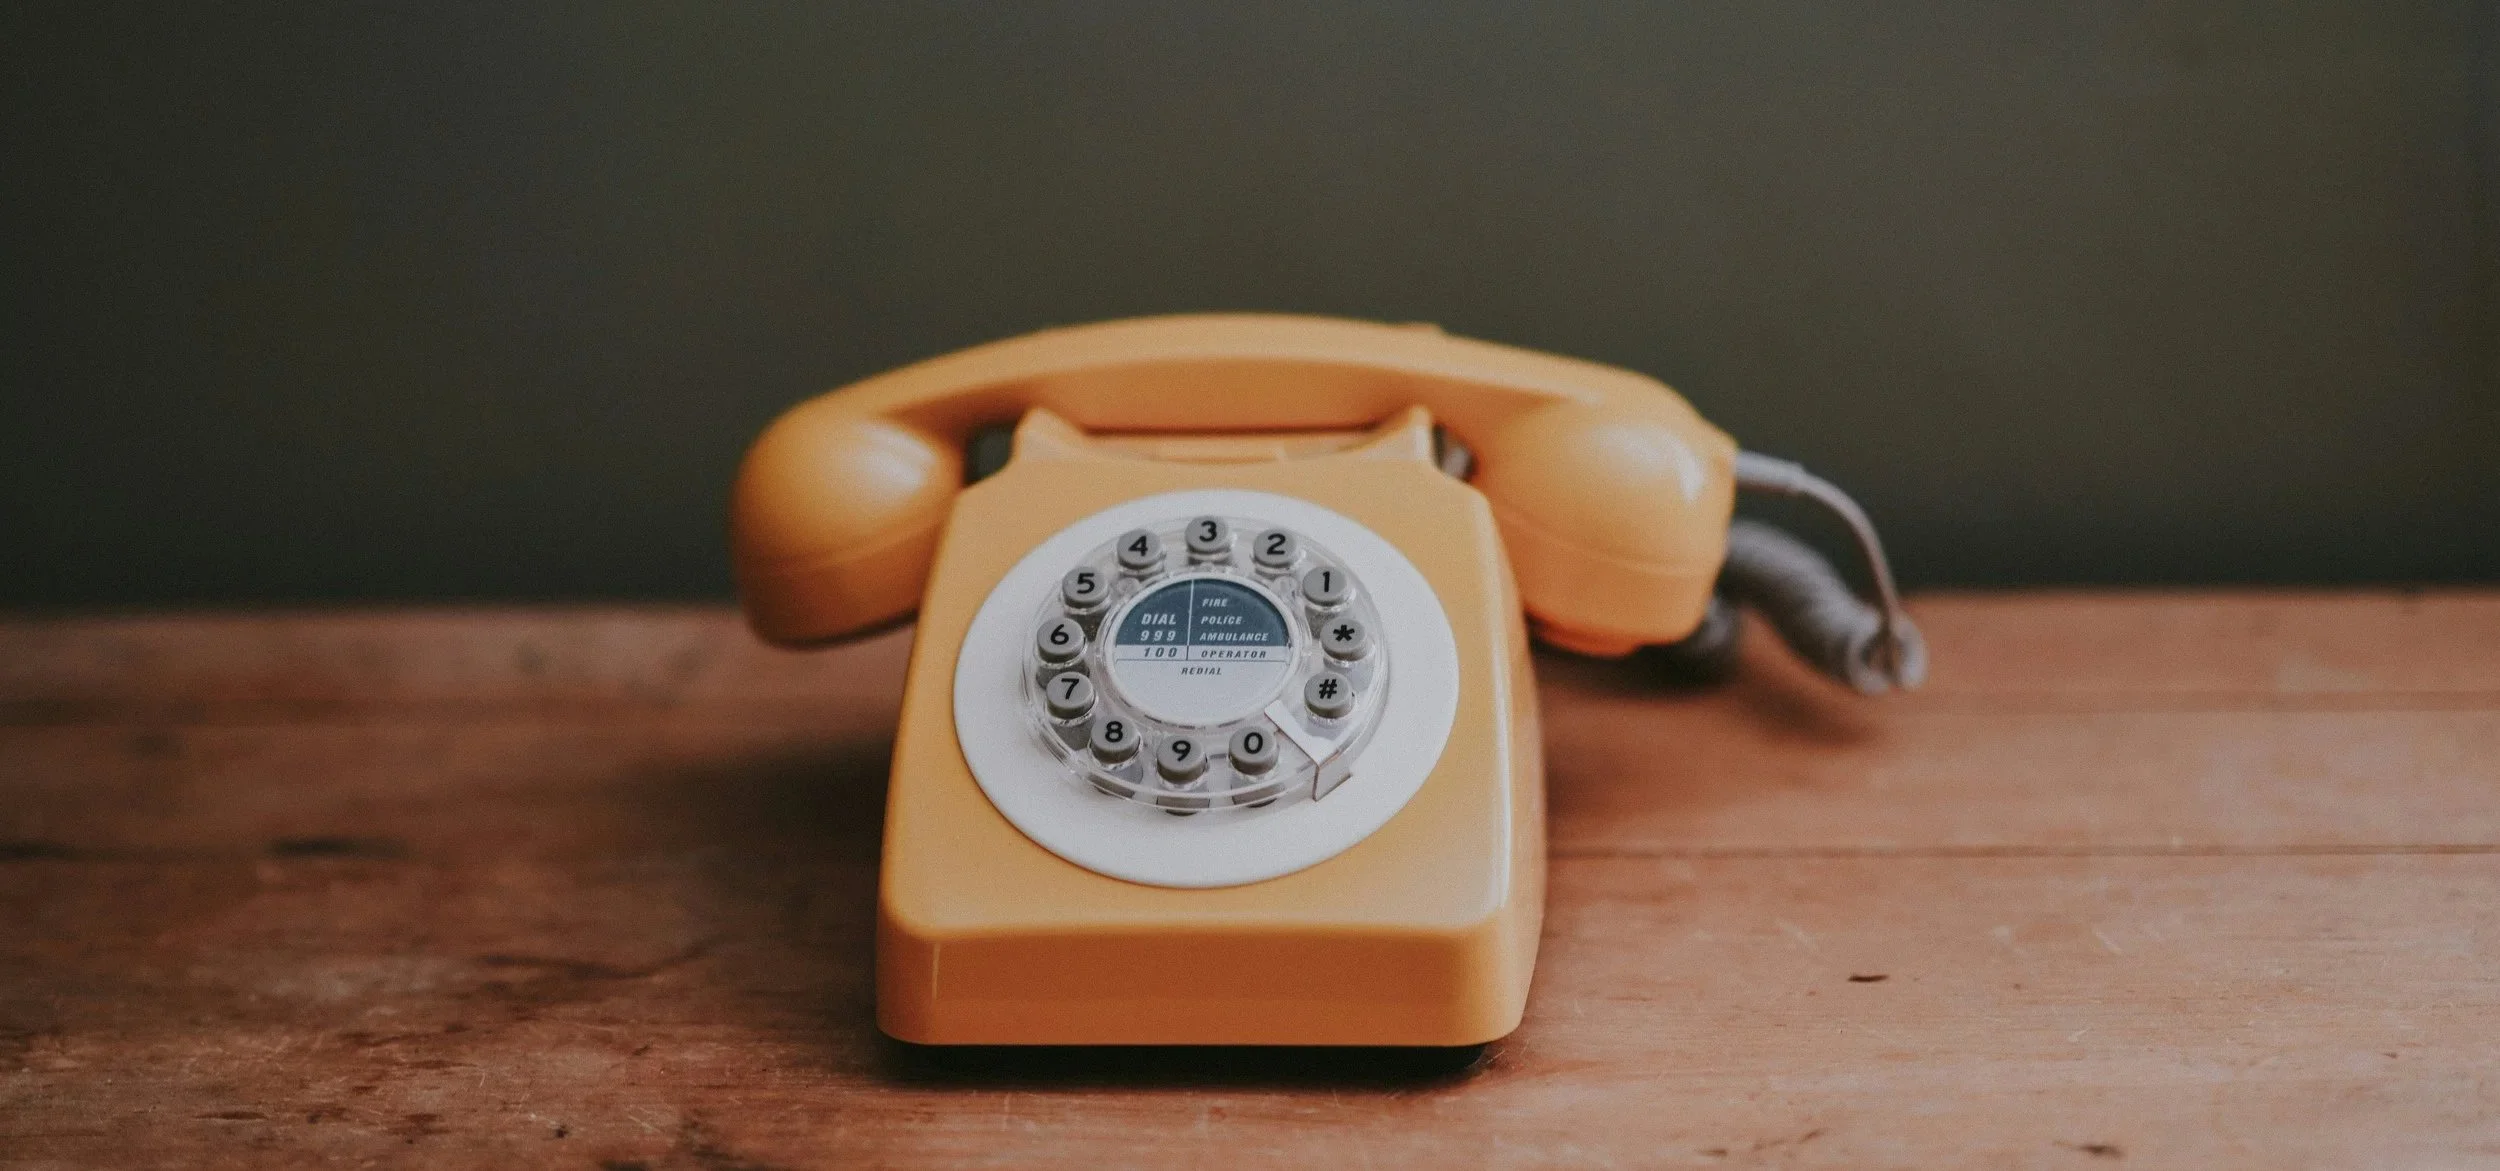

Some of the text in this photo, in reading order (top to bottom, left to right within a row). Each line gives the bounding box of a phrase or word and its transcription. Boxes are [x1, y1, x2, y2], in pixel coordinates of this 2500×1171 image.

[1199, 520, 1218, 543] 3
[1128, 535, 1149, 557] 4
[1266, 533, 1286, 556] 2
[1076, 572, 1096, 595] 5
[1322, 570, 1332, 593] 1
[1202, 598, 1228, 608] FIRE
[1141, 613, 1177, 625] DIAL
[1201, 615, 1243, 625] POLICE
[1050, 623, 1070, 646] 6
[1140, 630, 1176, 642] 999
[1200, 632, 1269, 642] AMBULANCE
[1144, 647, 1178, 658] 100
[1201, 649, 1267, 659] OPERATOR
[1181, 667, 1223, 676] REDIAL
[1060, 677, 1080, 700] 7
[1104, 720, 1124, 744] 8
[1243, 731, 1264, 755] 0
[1171, 740, 1192, 762] 9
